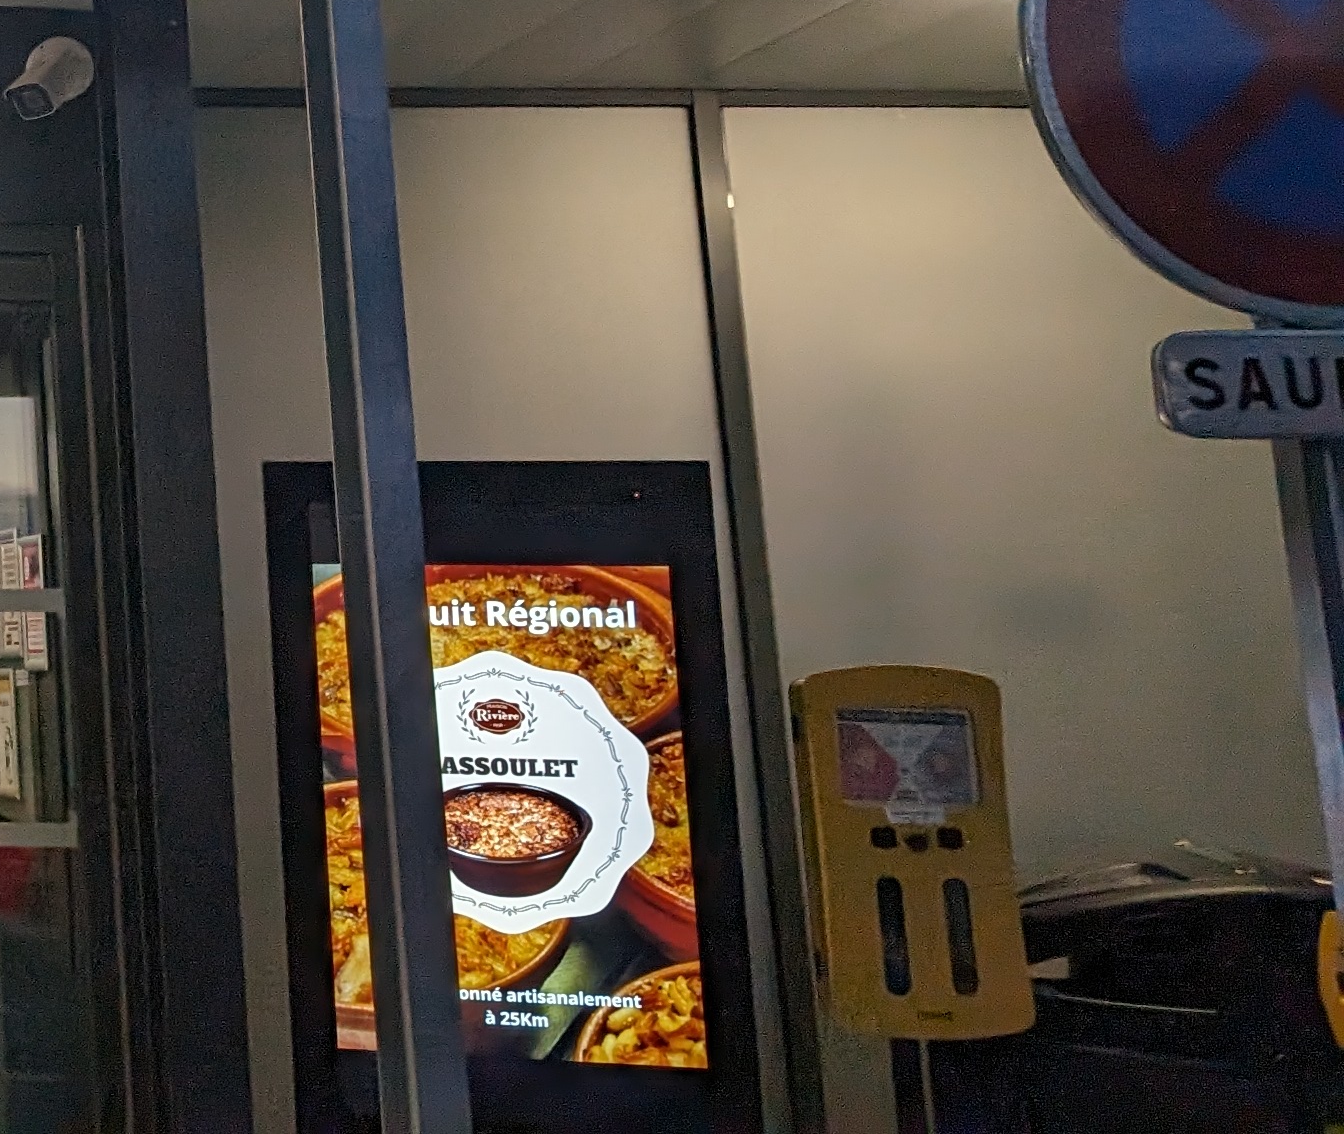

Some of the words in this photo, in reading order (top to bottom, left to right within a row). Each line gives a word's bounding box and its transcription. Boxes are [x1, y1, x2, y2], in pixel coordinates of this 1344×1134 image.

[485, 598, 636, 635] Régional
[476, 708, 520, 722] Rivière
[441, 756, 578, 778] ASSOULET
[506, 990, 643, 1009] artisanalement
[484, 1009, 496, 1026] à
[499, 1011, 550, 1029] 25Km
